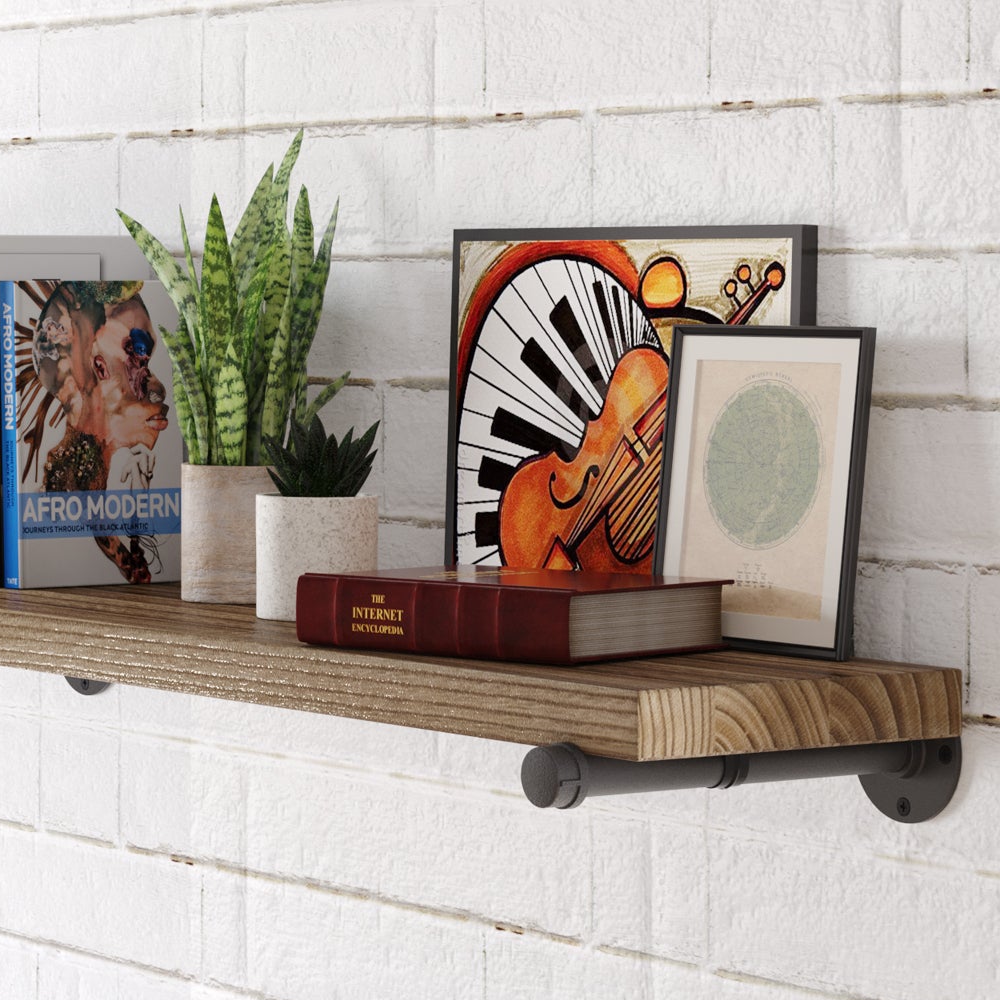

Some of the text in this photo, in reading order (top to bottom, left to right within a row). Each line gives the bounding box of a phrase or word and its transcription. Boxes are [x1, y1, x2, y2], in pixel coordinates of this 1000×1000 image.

[2, 303, 14, 430] AFRO MODERN
[23, 496, 83, 523] AFRO
[87, 493, 179, 521] MODERN
[23, 526, 53, 534] JOURNEYS
[371, 594, 385, 604] THE
[352, 607, 404, 622] INTERNET
[352, 623, 404, 636] ENCYCLOPEDIA
